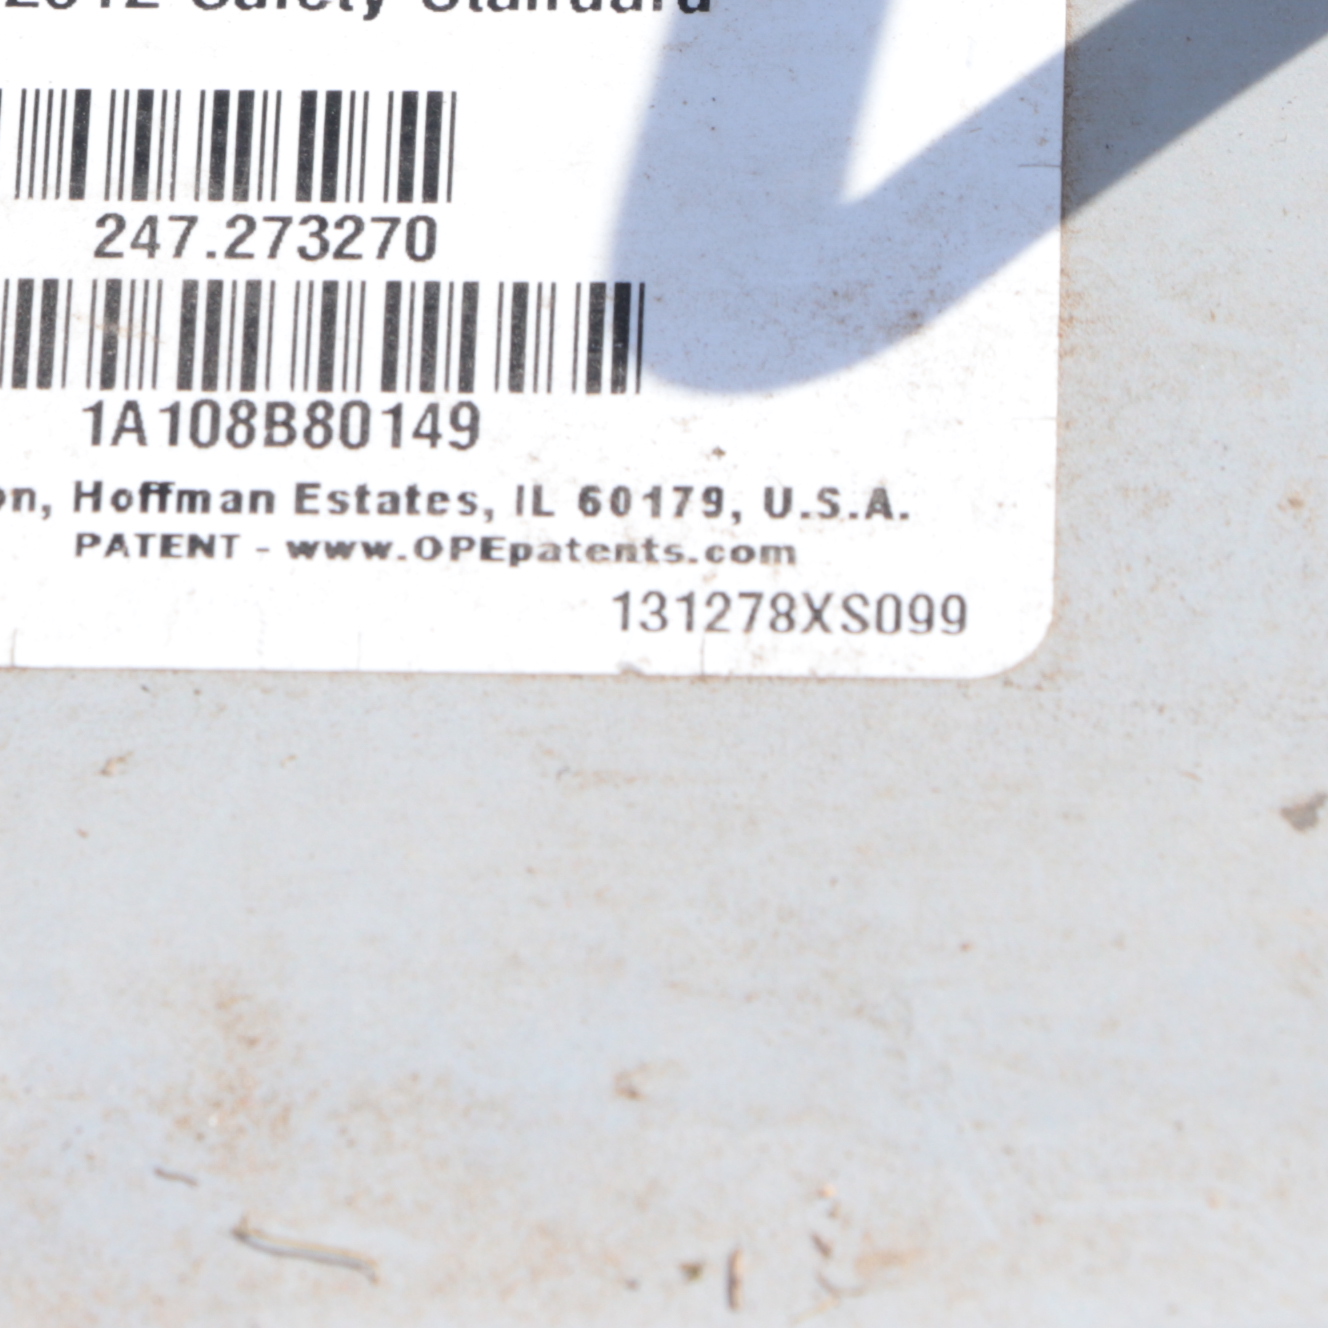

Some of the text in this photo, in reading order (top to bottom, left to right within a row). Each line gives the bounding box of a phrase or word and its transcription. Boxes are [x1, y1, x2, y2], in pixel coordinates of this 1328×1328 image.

[93, 212, 438, 263] 247.273270
[82, 398, 481, 452] 1A108B80149
[73, 480, 276, 515] Hoffman
[294, 482, 494, 523] Estates,
[515, 484, 555, 518] IL
[577, 484, 742, 525] 60179,
[763, 486, 910, 521] U.S.A.
[75, 532, 240, 559] PATENT
[285, 535, 796, 568] www.OPEpatents.com
[612, 590, 967, 635] 131278XS099
